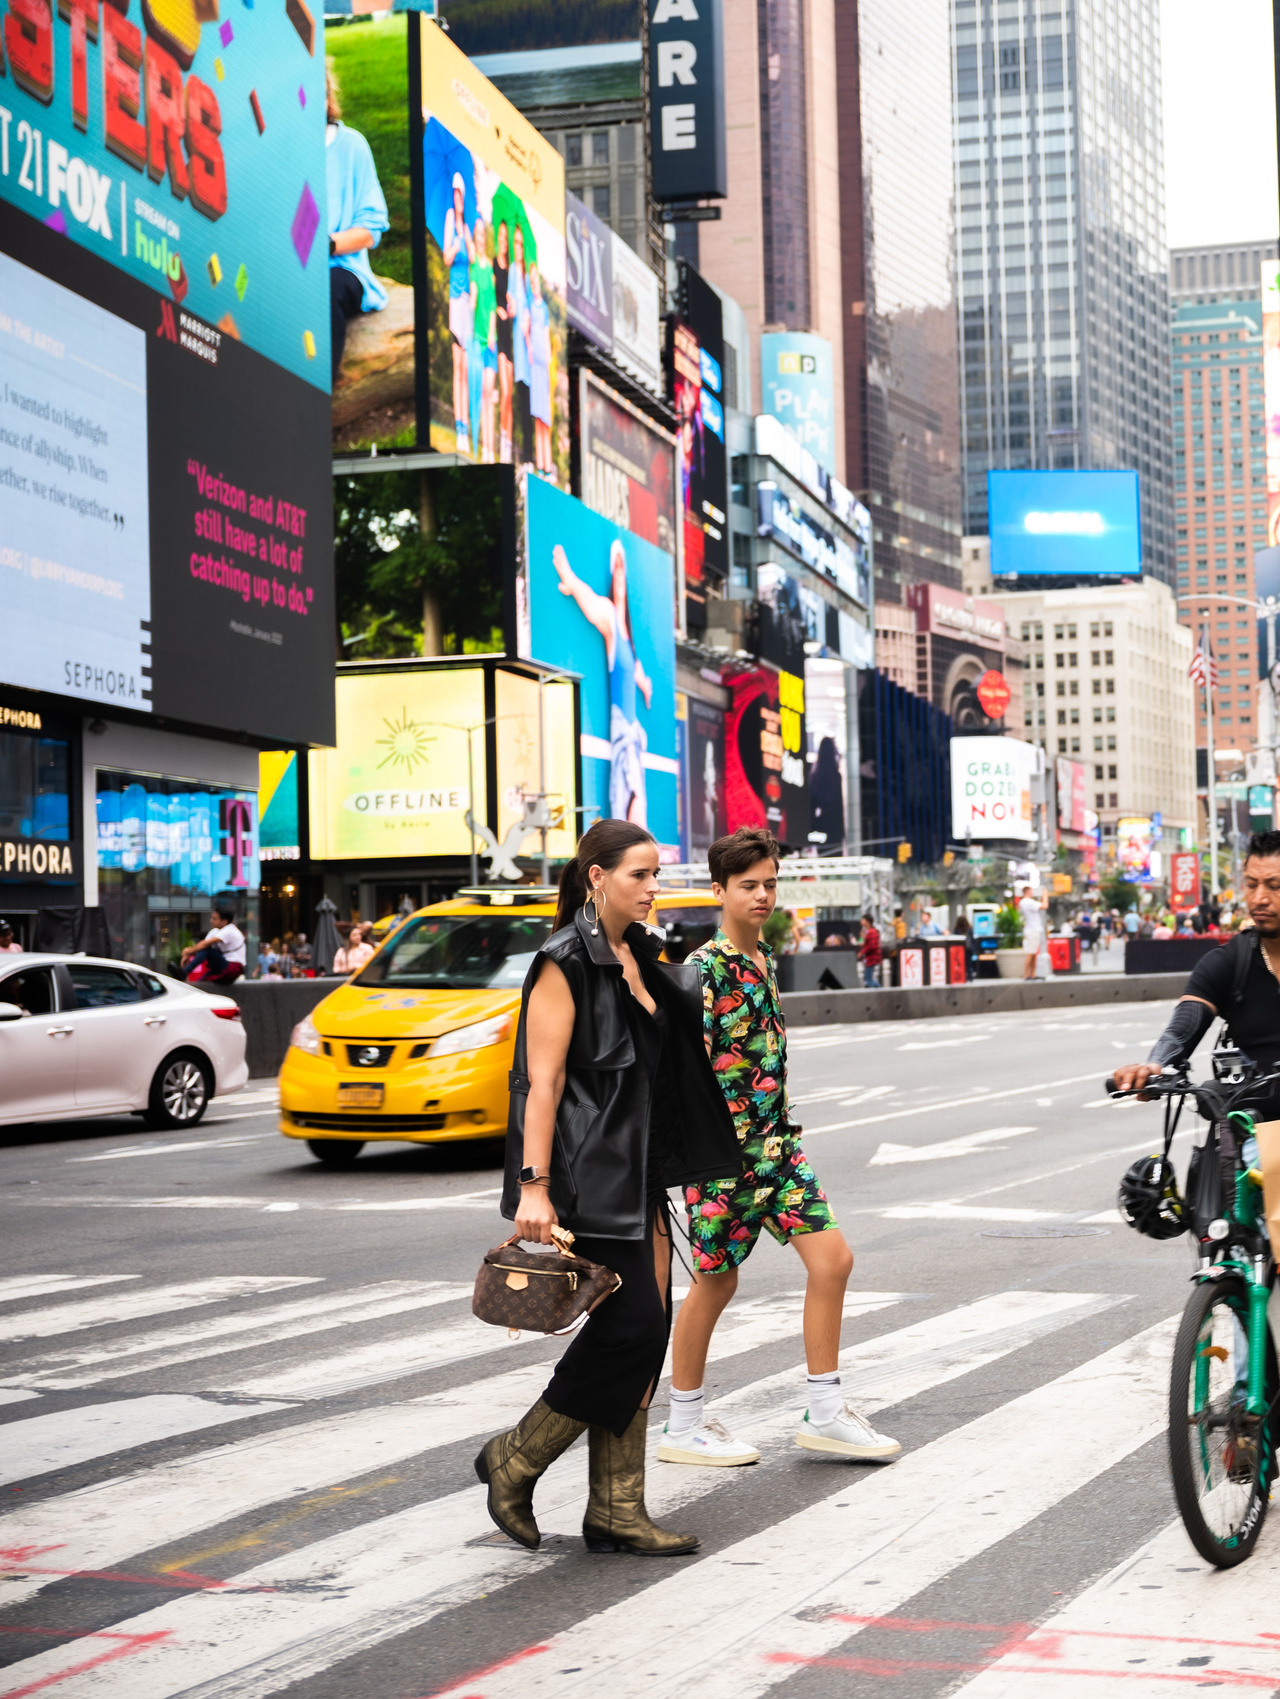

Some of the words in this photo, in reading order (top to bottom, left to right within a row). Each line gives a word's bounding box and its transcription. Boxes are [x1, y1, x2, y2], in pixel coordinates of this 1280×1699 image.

[17, 119, 43, 197] 21
[48, 138, 113, 241] FOX
[166, 217, 181, 241] ON
[135, 220, 181, 282] hulu
[566, 211, 610, 318] SIX
[180, 312, 222, 348] MARRIOTT
[180, 331, 219, 365] MARQUIS
[249, 494, 273, 525] and
[275, 499, 307, 538] AT&T
[194, 507, 222, 545] still
[225, 515, 257, 557] have
[259, 536, 268, 562] a
[270, 532, 288, 570] lot
[290, 545, 304, 574] of
[190, 552, 251, 602] catching
[253, 574, 270, 608] up
[272, 577, 286, 608] to
[64, 660, 136, 699] SEPHORA
[355, 791, 459, 812] OFFLINE
[965, 781, 1018, 797] DOZE
[0, 842, 73, 875] PHORA
[1176, 856, 1196, 892] tkts
